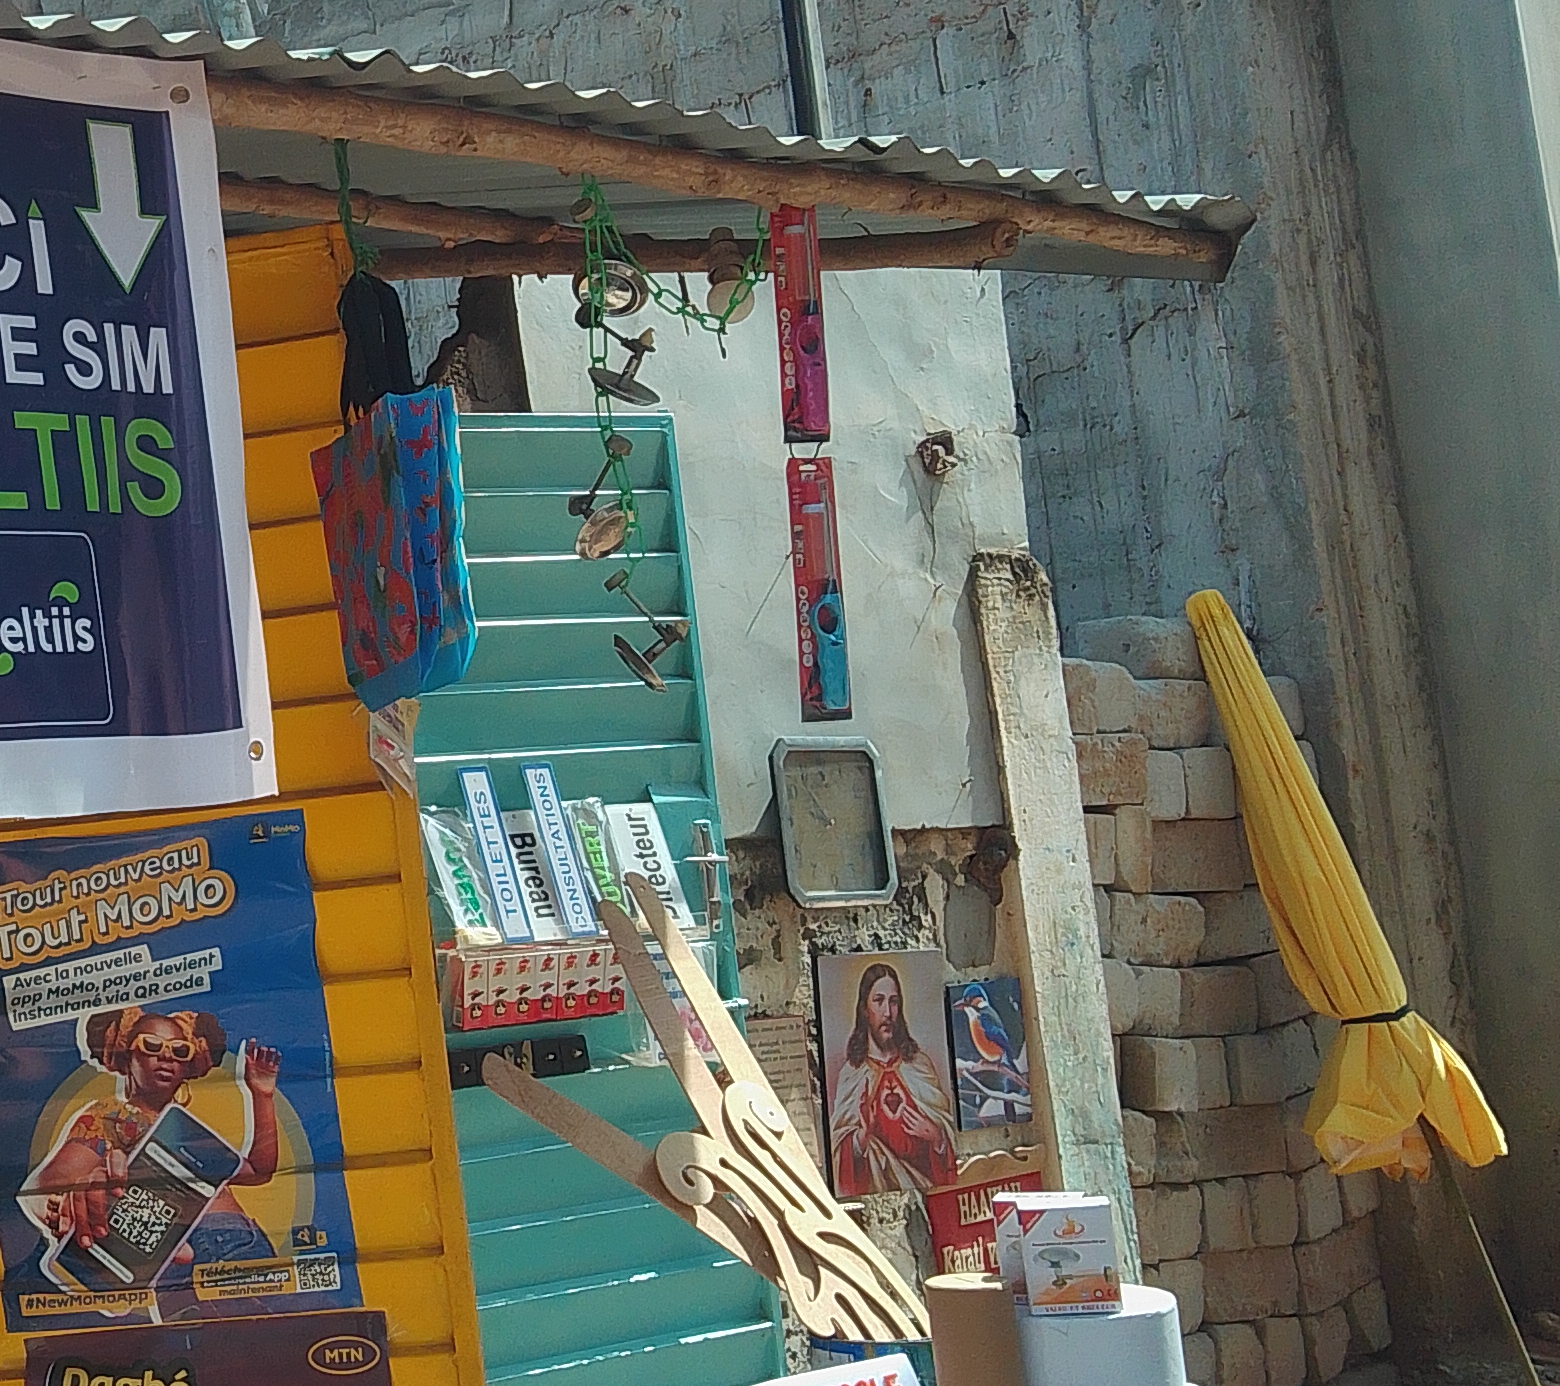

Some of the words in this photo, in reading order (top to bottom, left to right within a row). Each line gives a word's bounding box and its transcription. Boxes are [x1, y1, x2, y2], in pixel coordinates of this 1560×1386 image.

[63, 317, 175, 395] SIM
[71, 844, 200, 896] nouveau
[473, 789, 519, 920] TOILETTES
[508, 831, 556, 921] Bureau
[533, 768, 590, 930] CONSULTATIONS
[95, 875, 225, 934] MoMo
[11, 992, 41, 1010] app
[46, 981, 99, 999] MoMo,
[103, 970, 150, 995] payer
[153, 951, 216, 978] devient
[12, 973, 52, 991] Avec
[54, 967, 70, 986] la
[73, 949, 143, 978] nouvelle
[12, 993, 103, 1024] instantané
[105, 988, 130, 1006] via
[133, 981, 160, 1001] QR
[163, 973, 205, 995] code
[218, 1283, 284, 1298] maintenant
[266, 1271, 290, 1285] App
[324, 1347, 364, 1364] MTN
